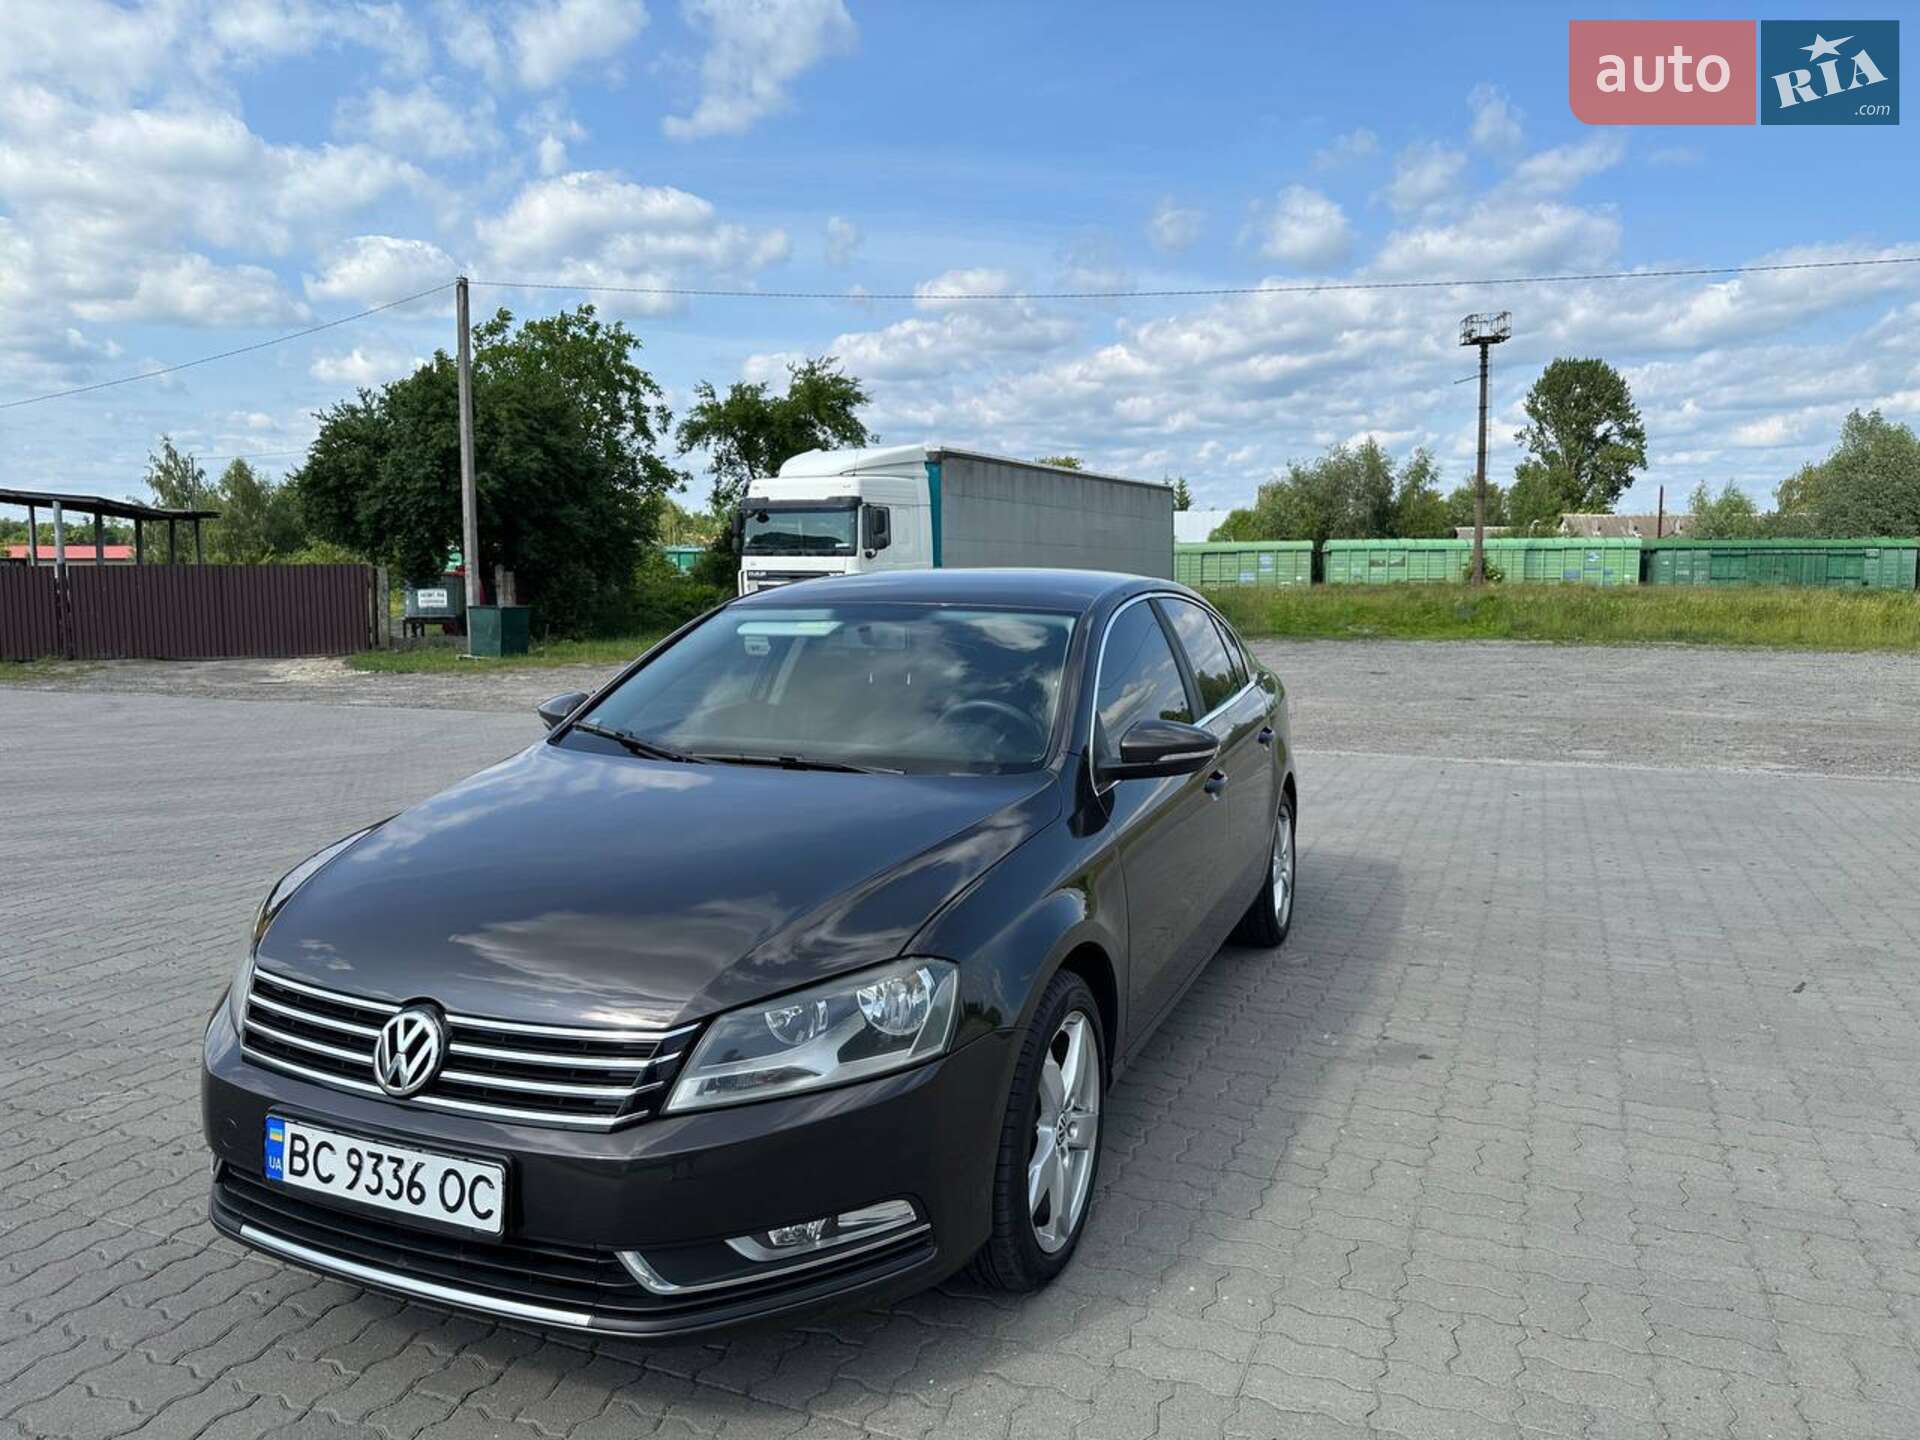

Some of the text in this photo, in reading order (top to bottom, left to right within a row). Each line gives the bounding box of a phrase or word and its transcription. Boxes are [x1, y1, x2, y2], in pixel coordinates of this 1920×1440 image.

[269, 1157, 283, 1170] UA
[289, 1133, 495, 1220] BC 9336 OC
